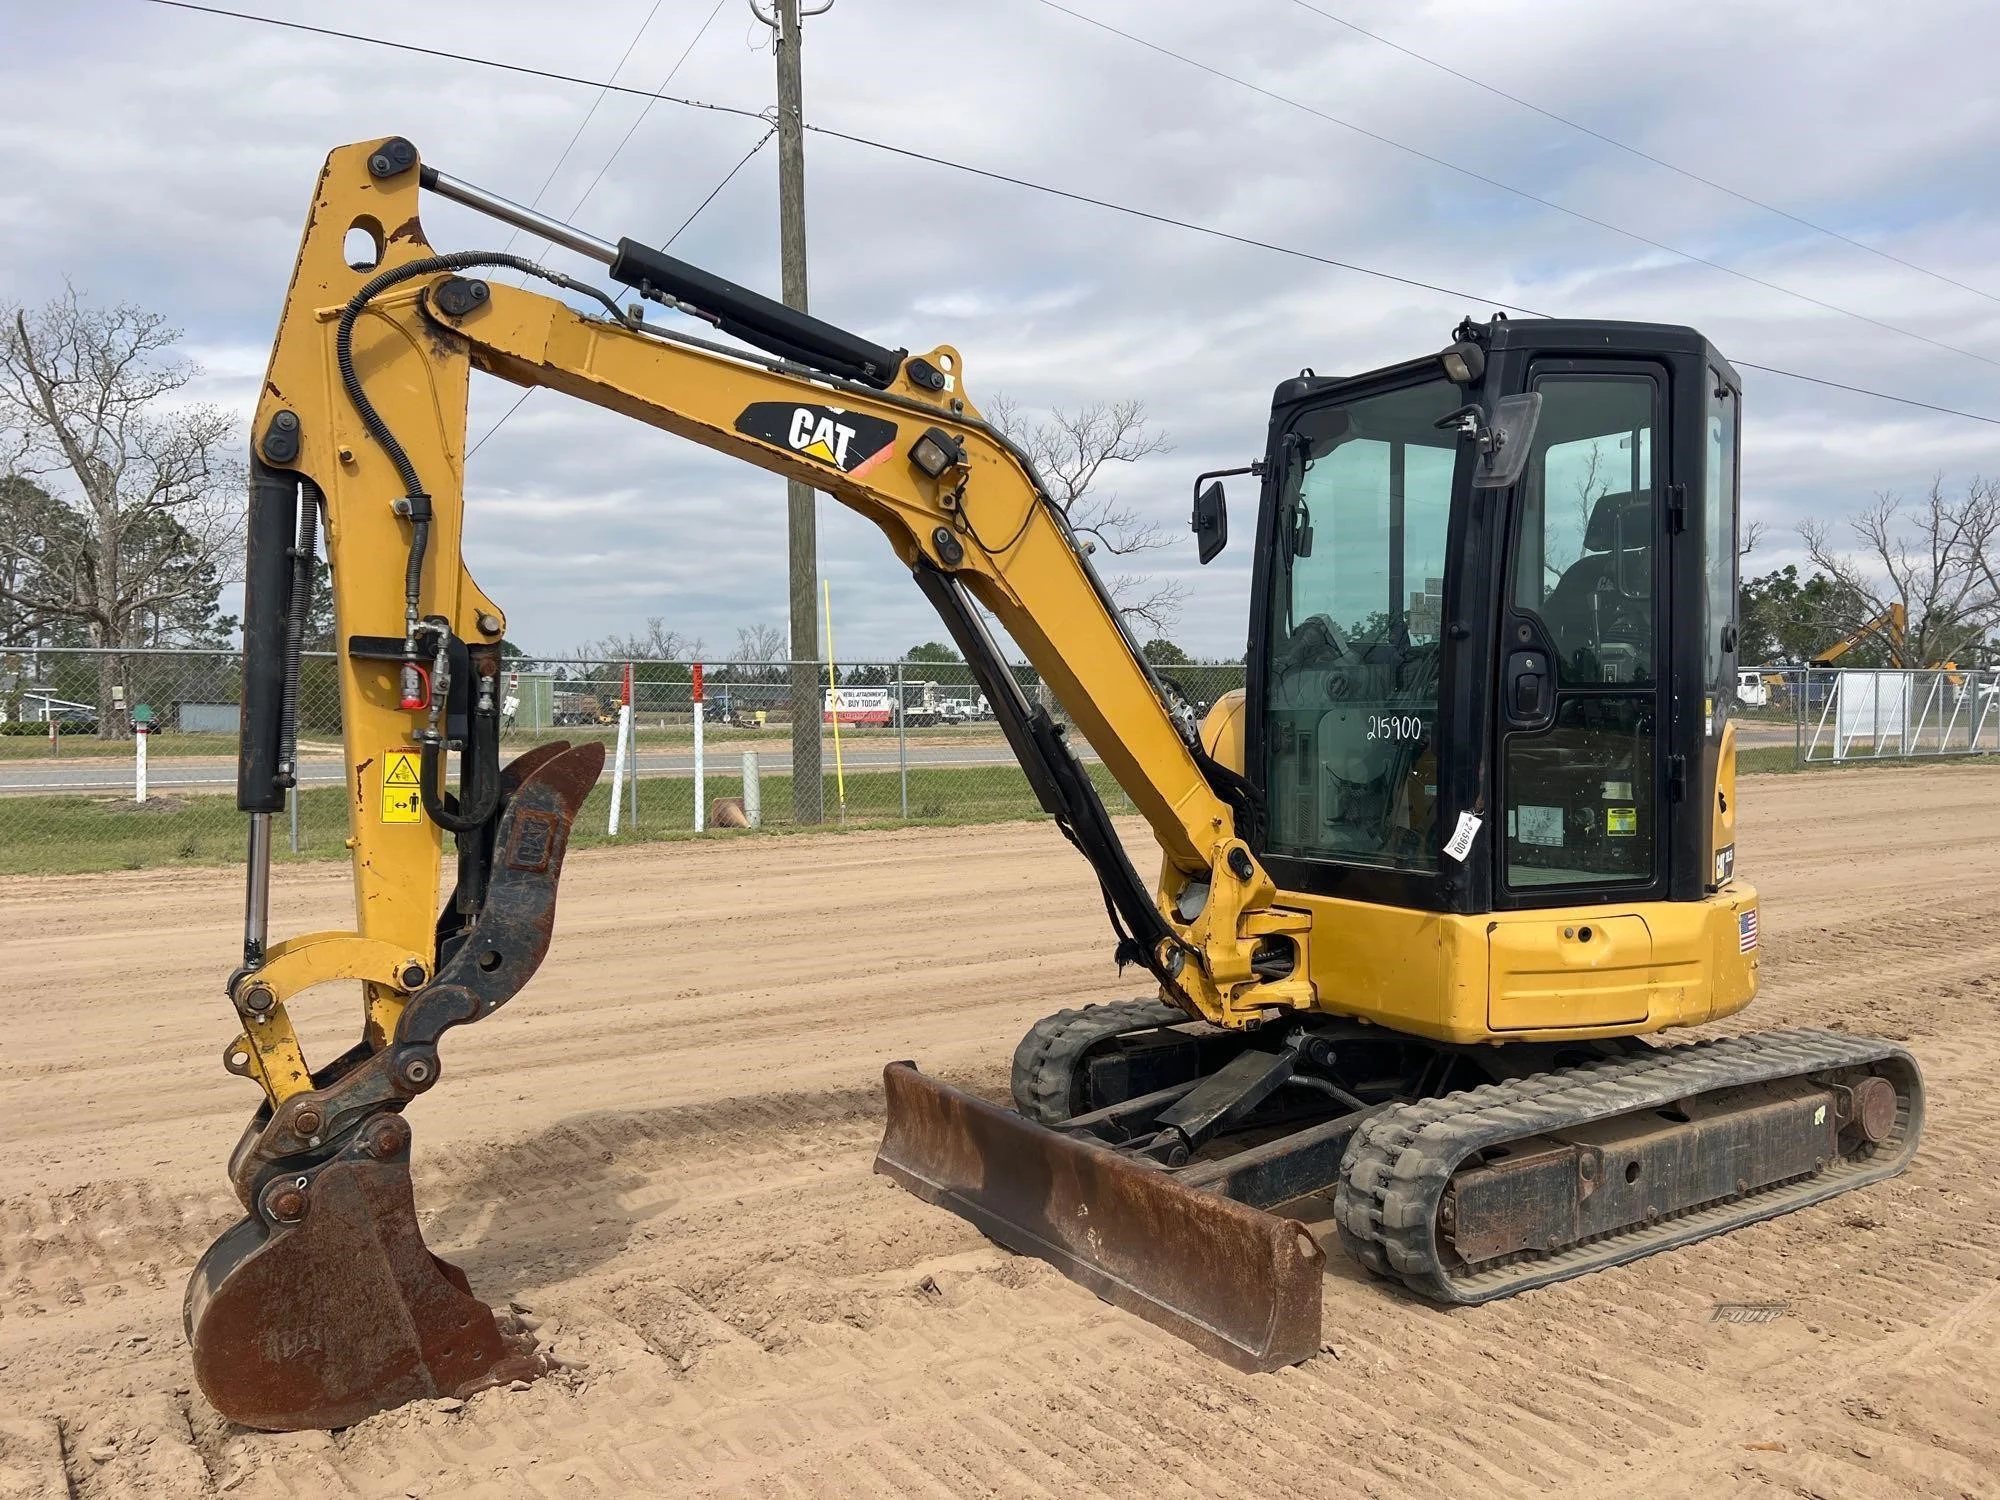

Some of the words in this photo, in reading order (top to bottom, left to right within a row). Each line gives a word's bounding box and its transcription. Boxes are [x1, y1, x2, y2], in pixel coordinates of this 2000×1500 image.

[788, 407, 856, 473] CAT
[1366, 715, 1421, 740] 215900
[1454, 823, 1473, 854] 215900
